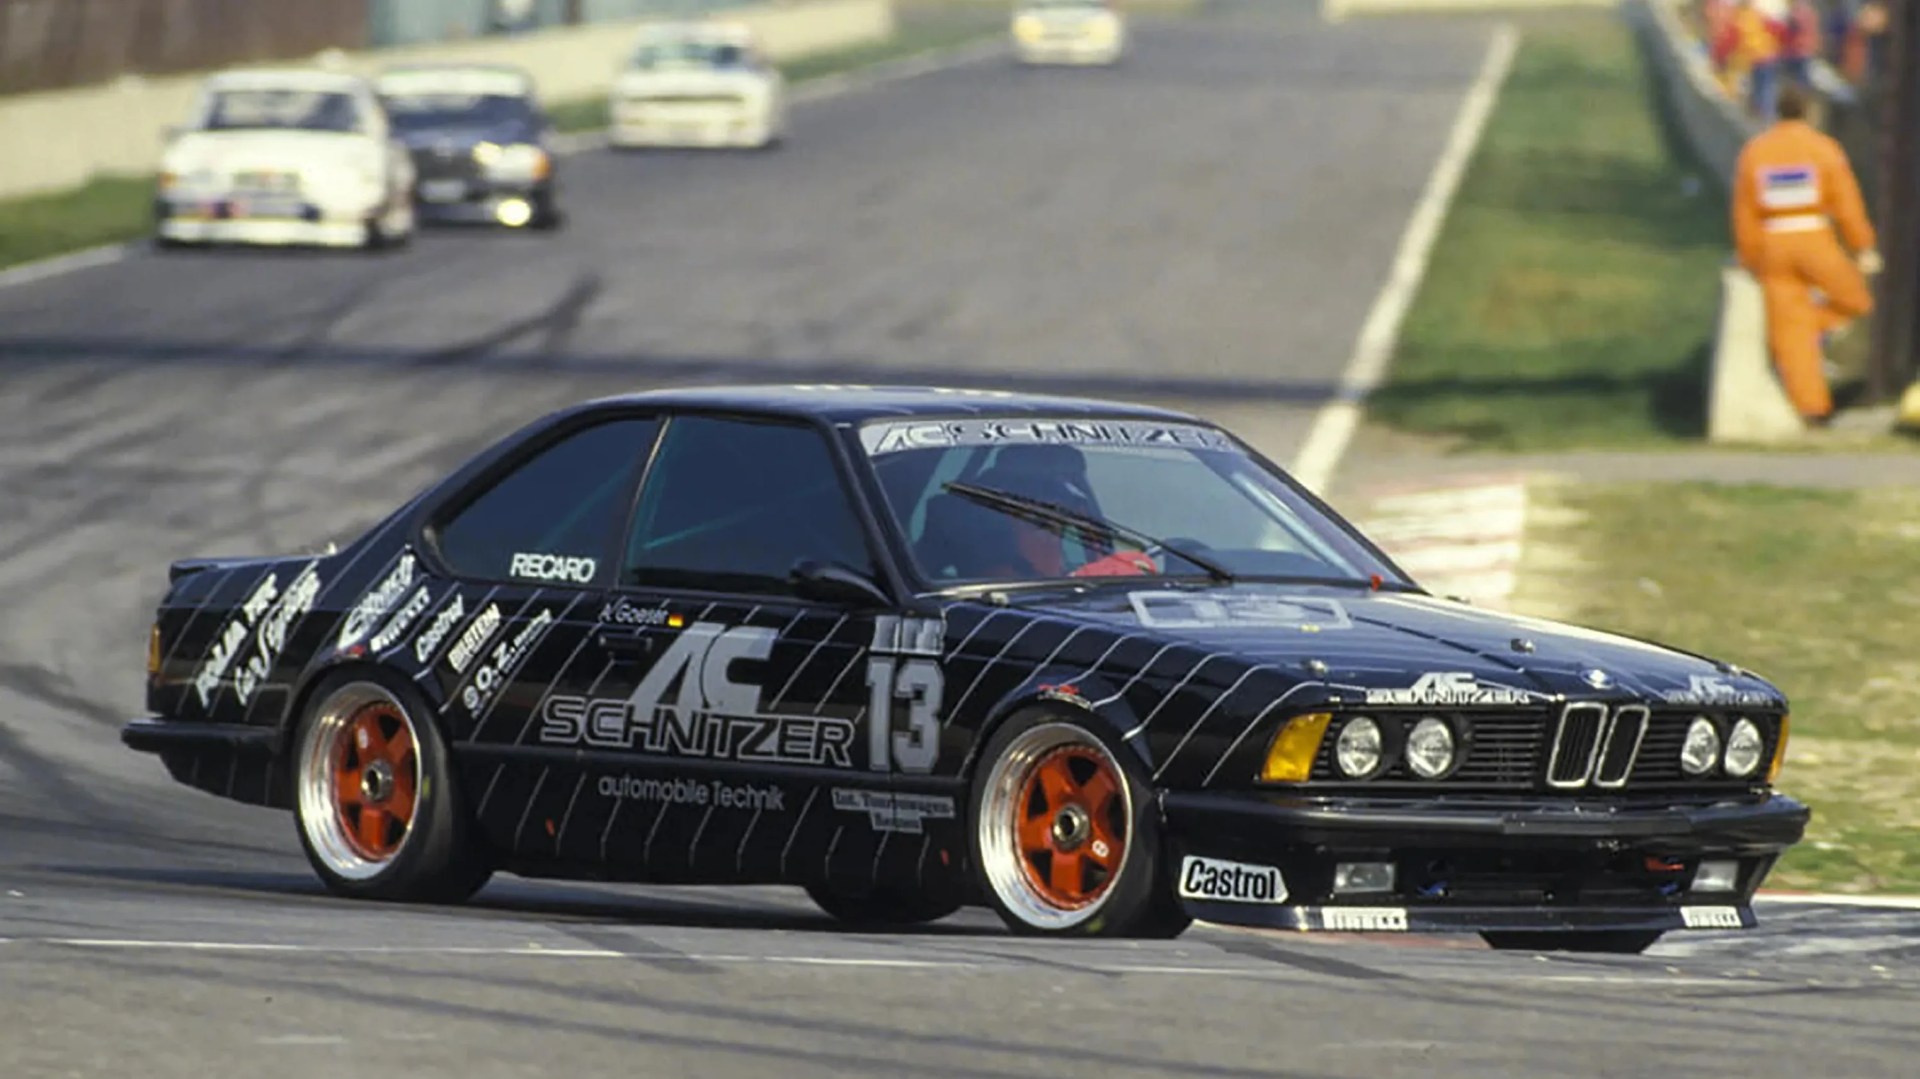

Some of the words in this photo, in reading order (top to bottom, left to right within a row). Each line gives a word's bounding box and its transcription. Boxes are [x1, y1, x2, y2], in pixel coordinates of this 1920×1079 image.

[510, 552, 596, 583] RECARO
[415, 593, 464, 663] Castrol
[627, 622, 779, 721] AC
[1412, 671, 1479, 692] AC
[540, 695, 855, 767] SCHNITZER
[864, 654, 946, 774] 13
[600, 774, 706, 803] automobile
[711, 774, 785, 809] Technik
[1183, 858, 1275, 901] Castrol
